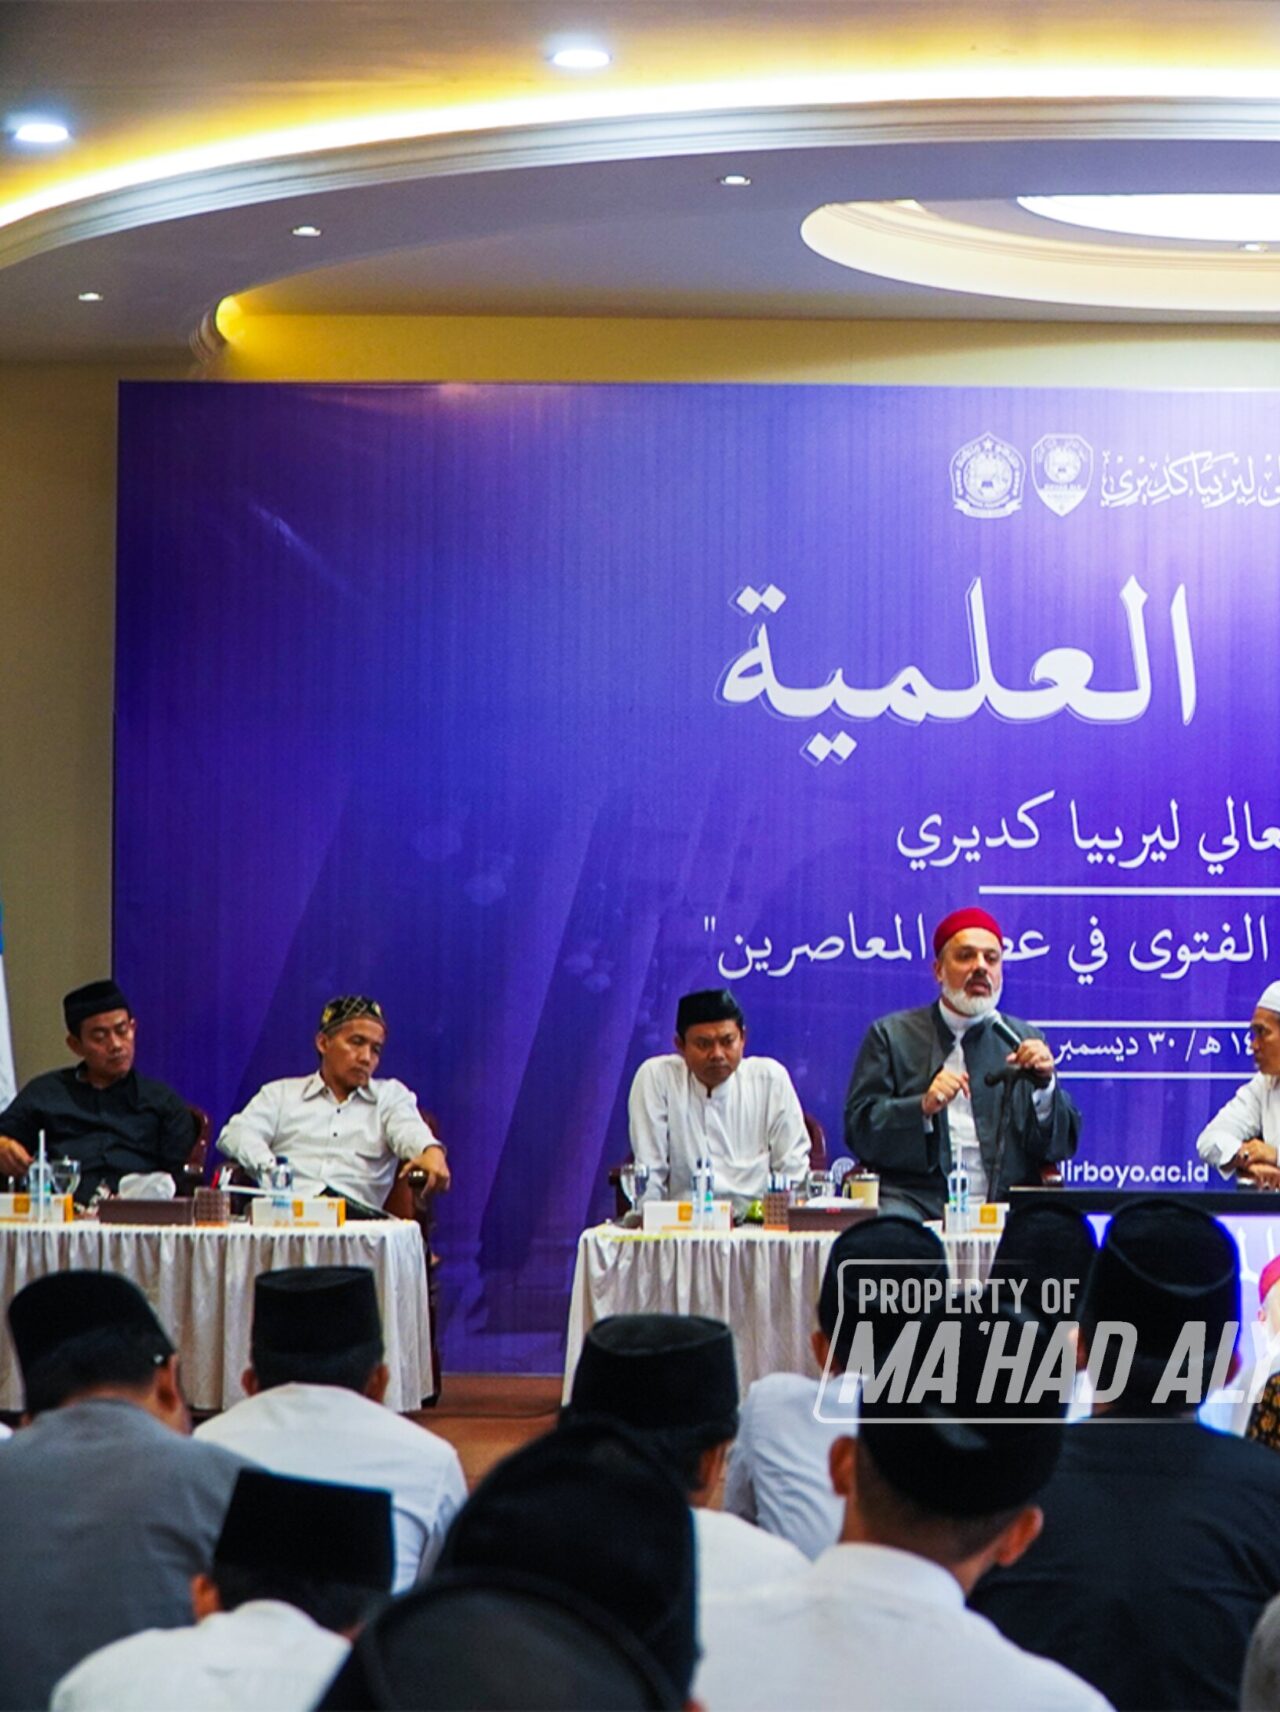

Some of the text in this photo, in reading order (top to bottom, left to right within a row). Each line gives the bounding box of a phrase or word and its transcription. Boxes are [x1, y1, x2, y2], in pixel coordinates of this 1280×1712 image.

[715, 573, 1198, 765] العلمية
[896, 790, 1055, 871] كديري
[1069, 799, 1180, 868] ليربيا
[1068, 915, 1108, 985] في
[1129, 913, 1268, 980] الفتوى
[1053, 1037, 1140, 1065] ديسمبر
[1148, 1032, 1176, 1054] ٣٠
[1058, 1159, 1209, 1189] lirboyo.ac.id
